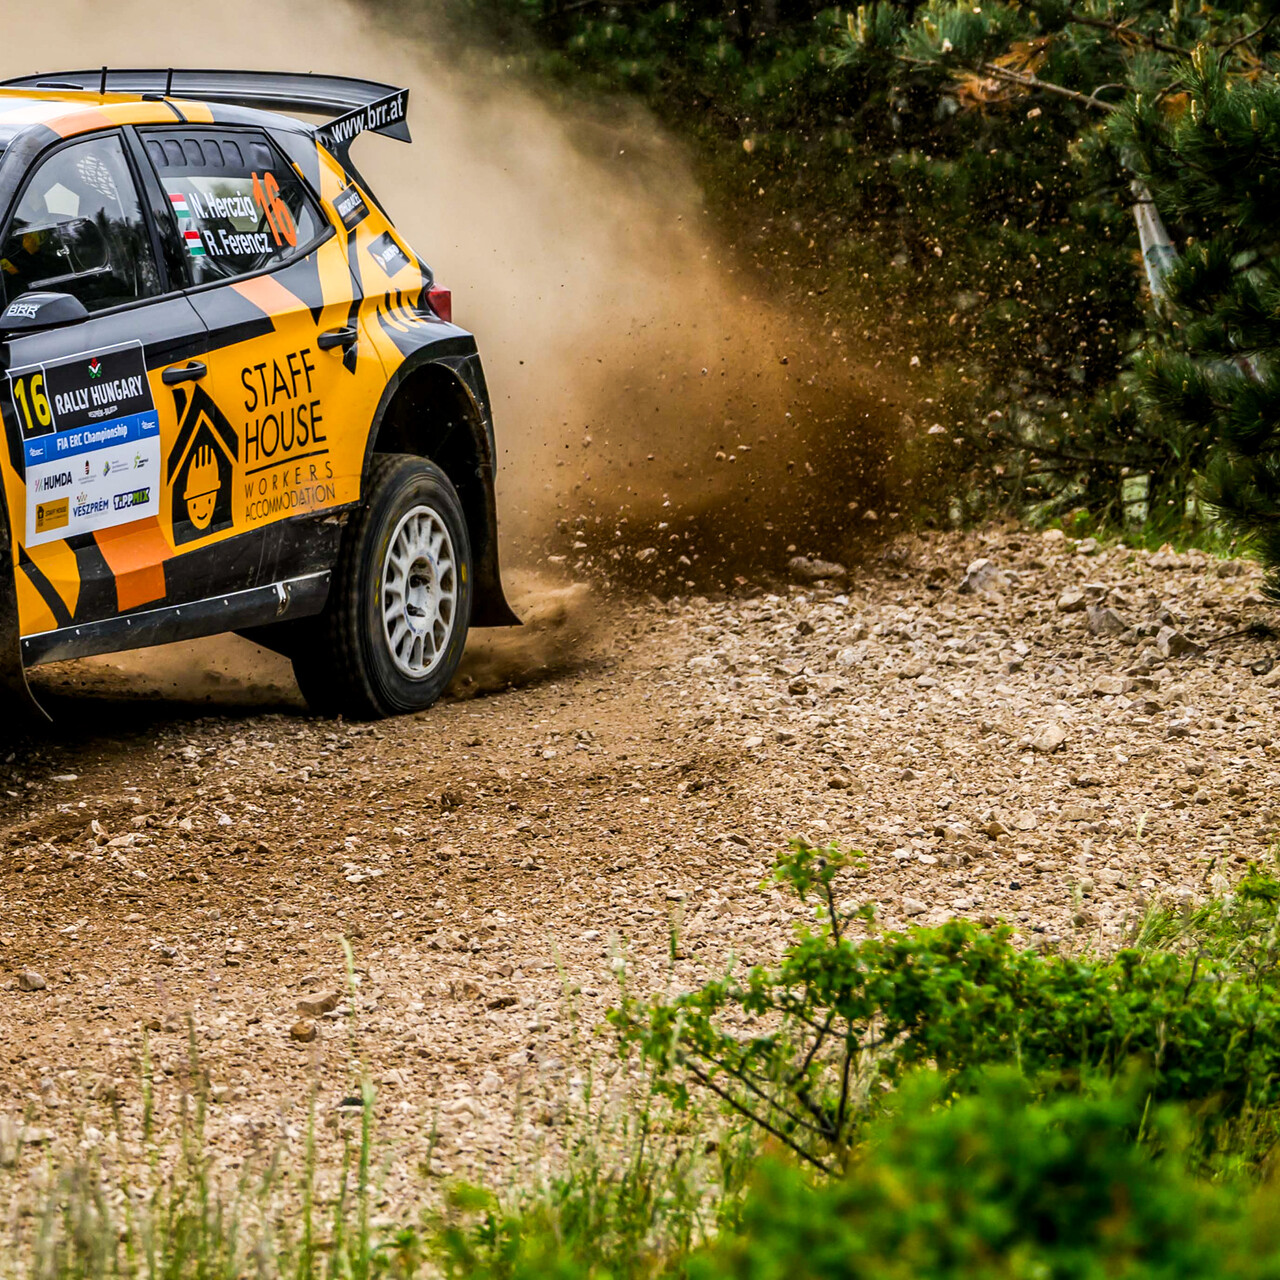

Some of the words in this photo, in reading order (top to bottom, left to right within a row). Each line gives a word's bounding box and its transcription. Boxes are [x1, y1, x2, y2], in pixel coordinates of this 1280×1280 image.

[331, 94, 403, 143] www.brr.at
[189, 193, 208, 219] N.
[208, 191, 258, 223] Herczig
[251, 172, 298, 248] 16
[203, 230, 223, 256] R.
[219, 229, 273, 255] Ferencz
[7, 304, 40, 319] BRR
[54, 388, 89, 415] RALLY
[90, 375, 143, 406] HUNGARY
[241, 348, 315, 412] STAFF
[14, 374, 51, 429] 16
[57, 438, 69, 451] FIA
[70, 432, 82, 447] ERC
[83, 424, 128, 444] Championship
[245, 400, 327, 463] HOUSE
[44, 471, 73, 491] HUMDA
[245, 461, 333, 499] WORKERS
[73, 497, 109, 517] VESZPRÉM
[245, 482, 335, 522] ACCOMMODATION
